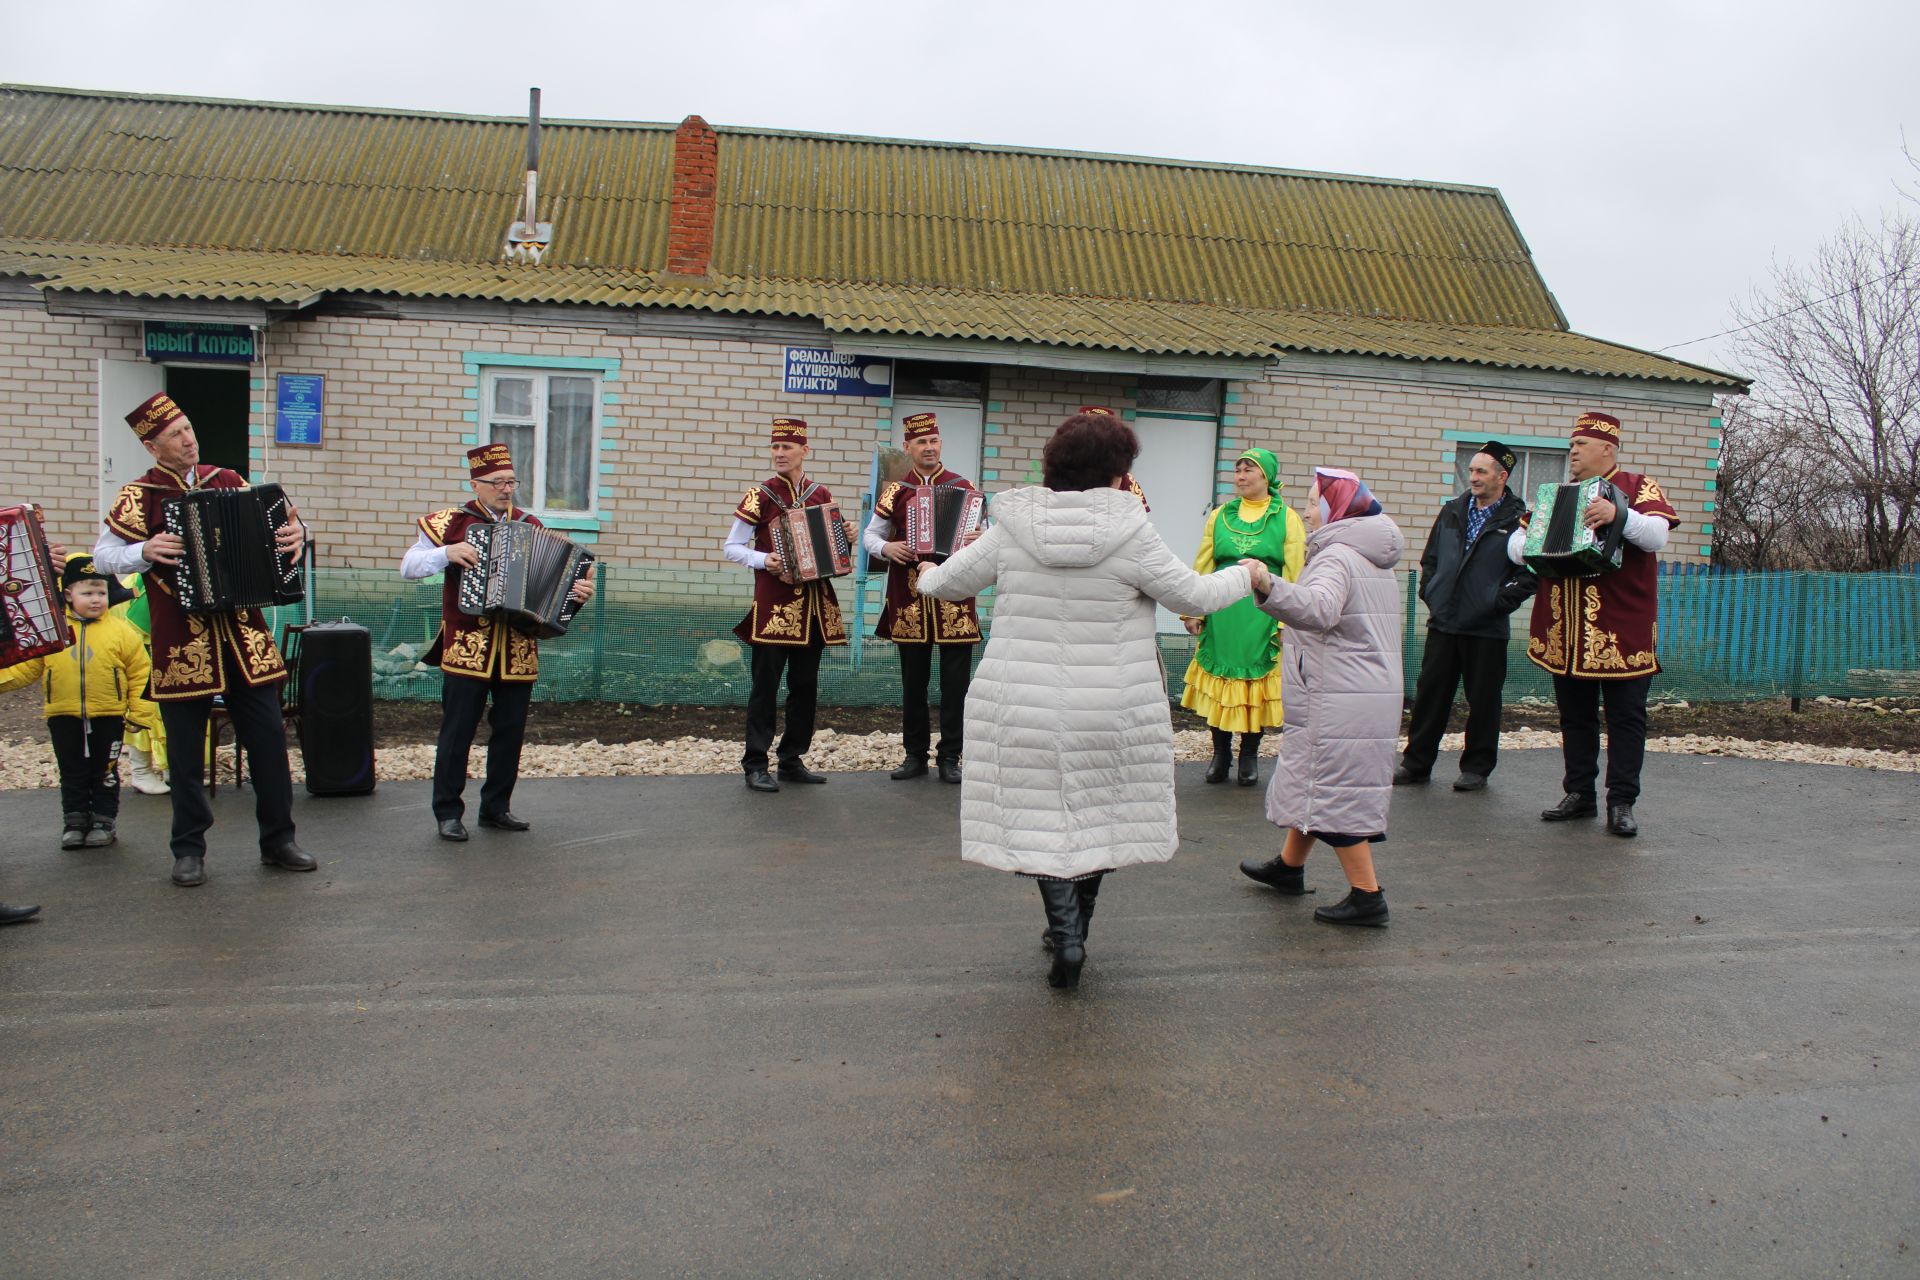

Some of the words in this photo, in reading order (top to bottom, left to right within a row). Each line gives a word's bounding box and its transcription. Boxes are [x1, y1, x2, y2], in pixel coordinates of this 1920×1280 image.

[146, 332, 193, 353] АВЫЛ
[198, 334, 253, 355] КЛУБЫ
[788, 376, 838, 391] ПУНКТЫ
